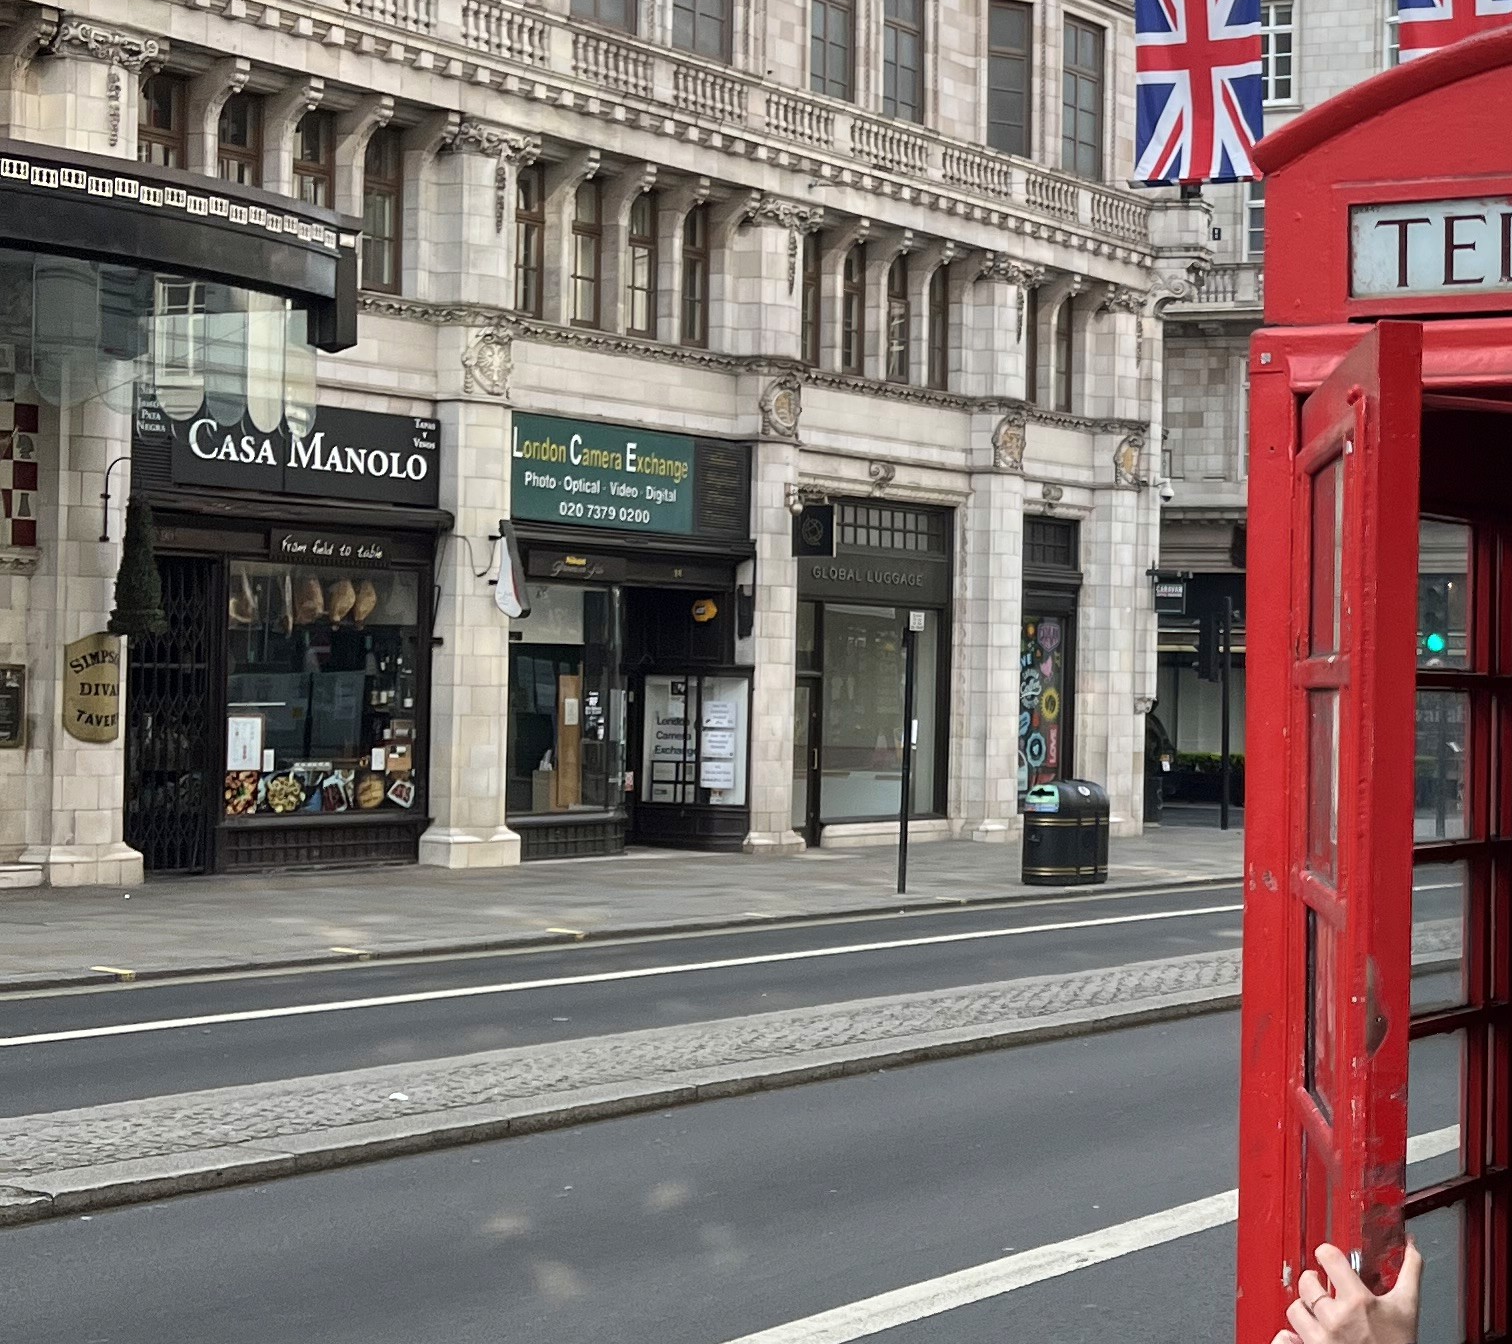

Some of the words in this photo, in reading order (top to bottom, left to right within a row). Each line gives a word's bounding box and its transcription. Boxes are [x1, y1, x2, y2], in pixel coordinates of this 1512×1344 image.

[188, 418, 277, 466] CASA
[287, 431, 428, 481] MANOLO
[512, 426, 567, 464] London
[569, 433, 622, 471] Camera
[625, 442, 689, 484] Exchange
[524, 471, 557, 489] Photo
[563, 475, 601, 495] Optical
[609, 481, 639, 499] Video
[645, 485, 677, 505] Digital
[559, 501, 584, 518] 020
[586, 504, 617, 521] 7379
[619, 509, 650, 524] 0200
[812, 565, 863, 582] GLOBAL
[866, 570, 924, 587] LUGGAGE
[79, 682, 120, 696] DIVA
